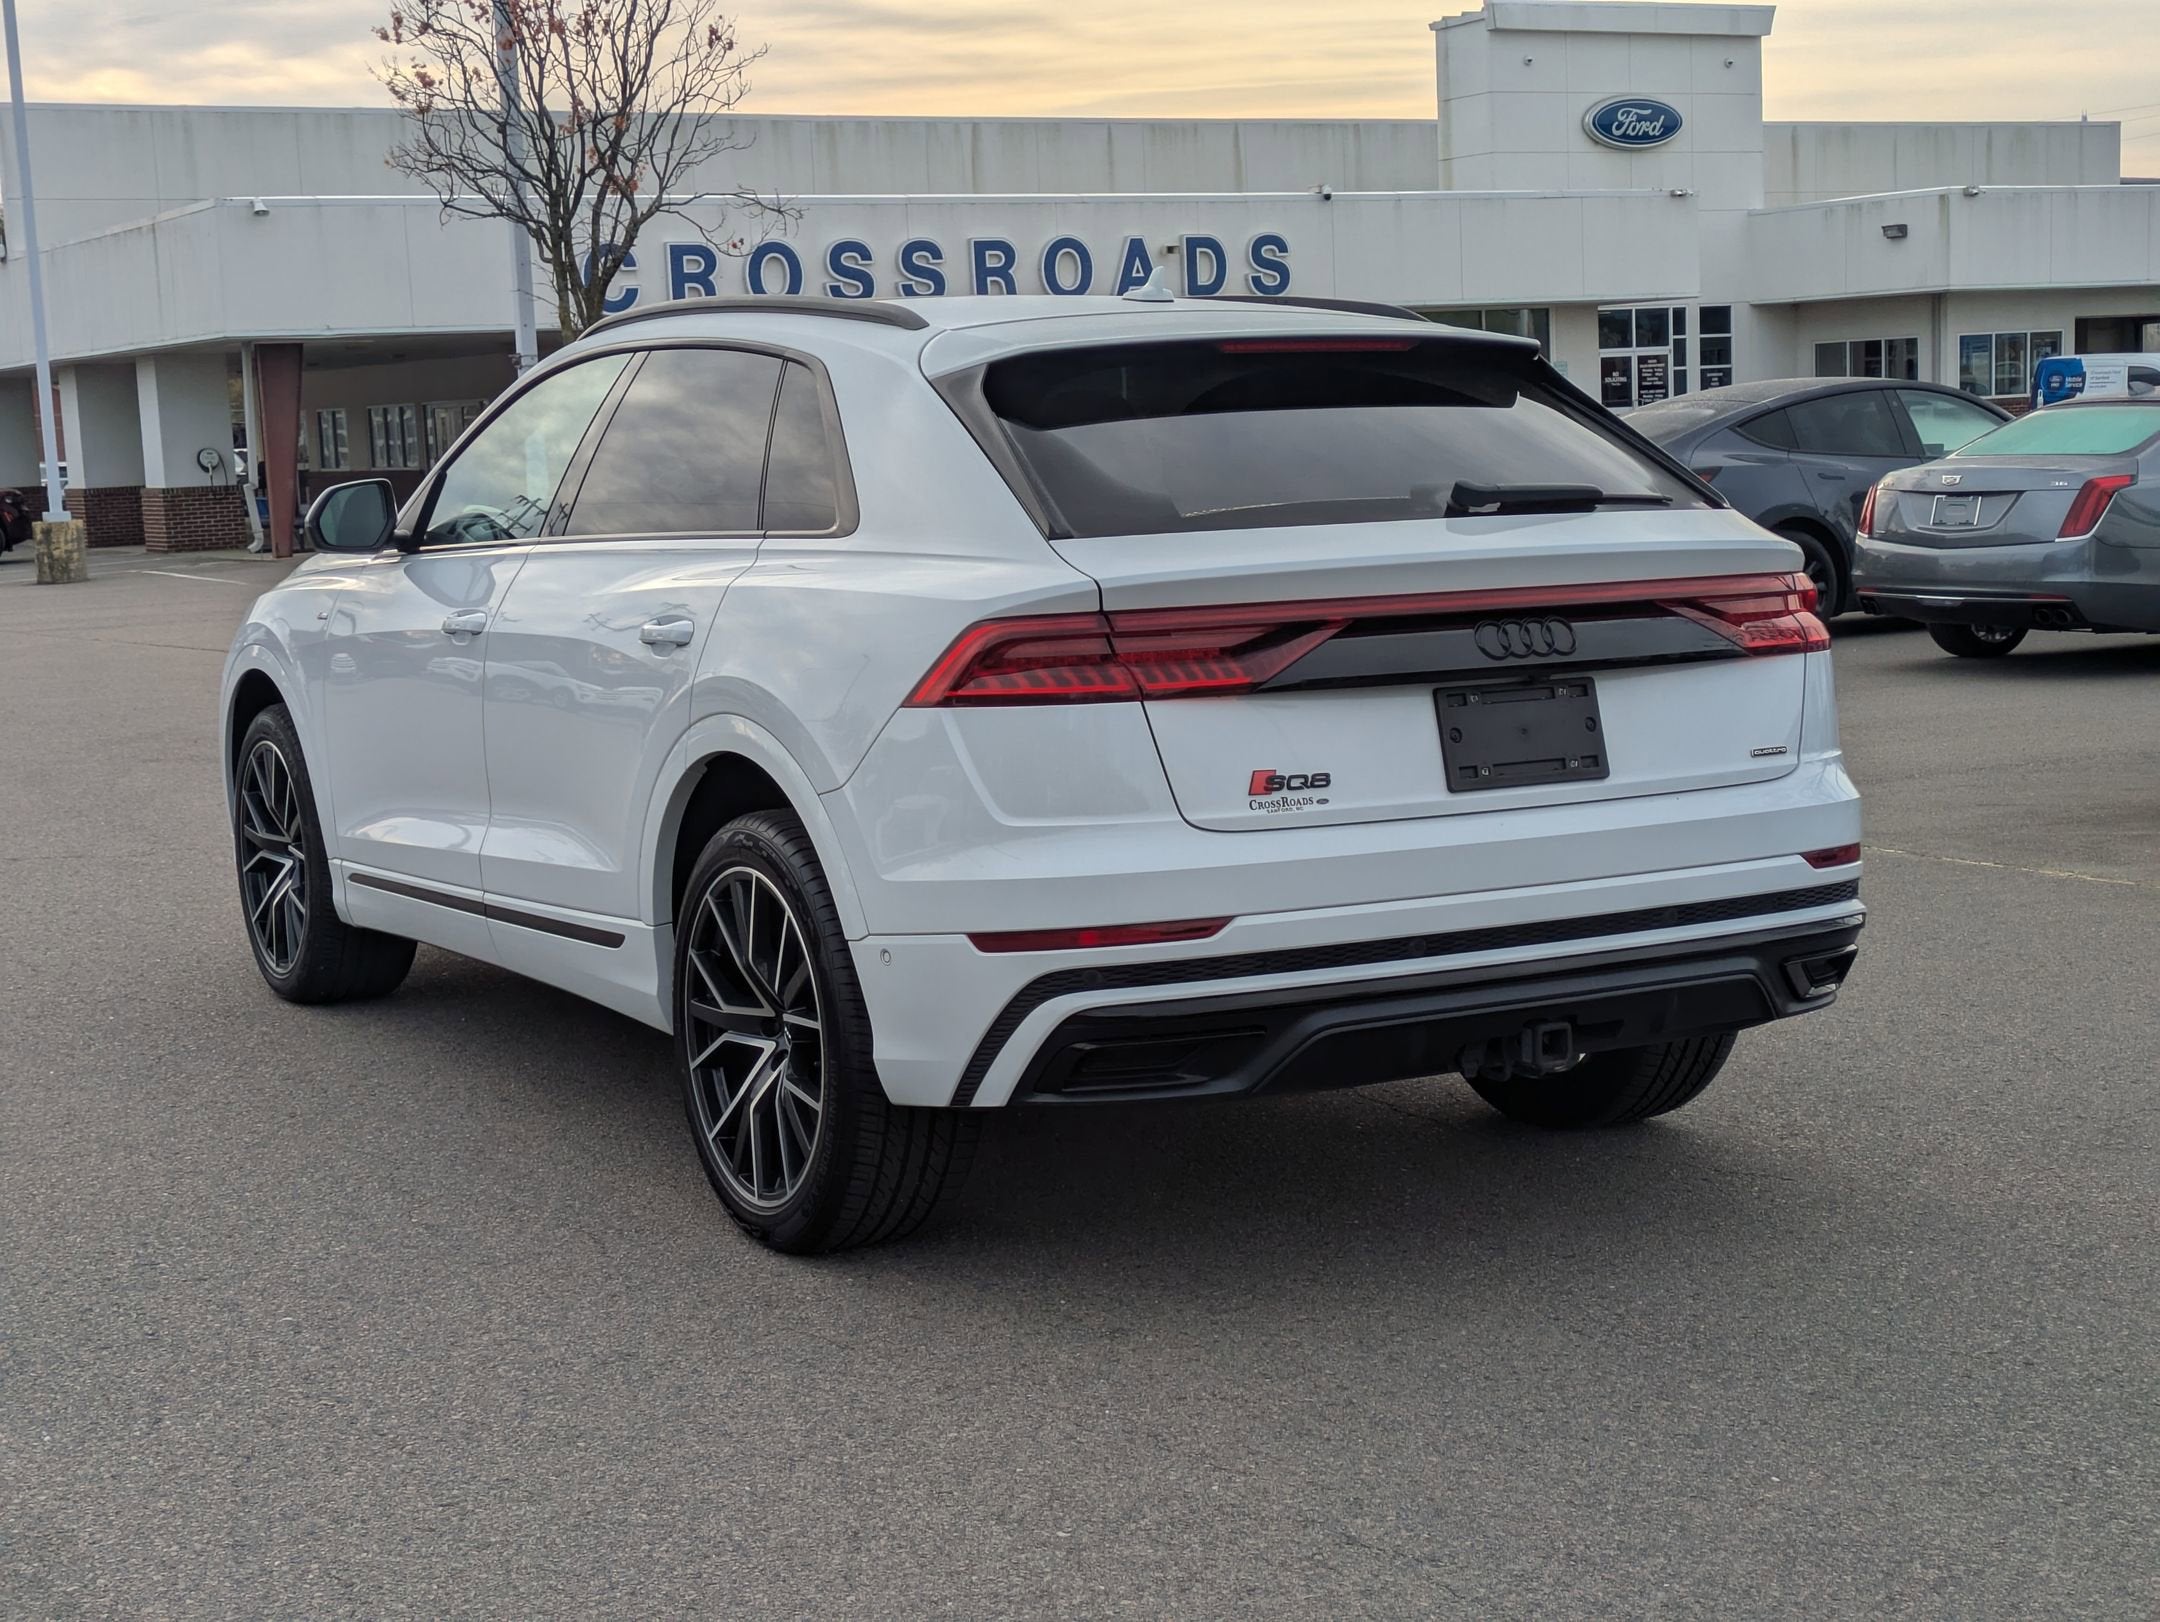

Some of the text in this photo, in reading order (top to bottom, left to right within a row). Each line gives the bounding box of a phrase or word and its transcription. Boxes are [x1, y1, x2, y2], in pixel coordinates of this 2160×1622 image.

[1612, 107, 1664, 136] Ford
[581, 232, 1291, 313] CROSSROADS
[1753, 747, 1787, 756] quattro
[1264, 772, 1331, 791] SQ8
